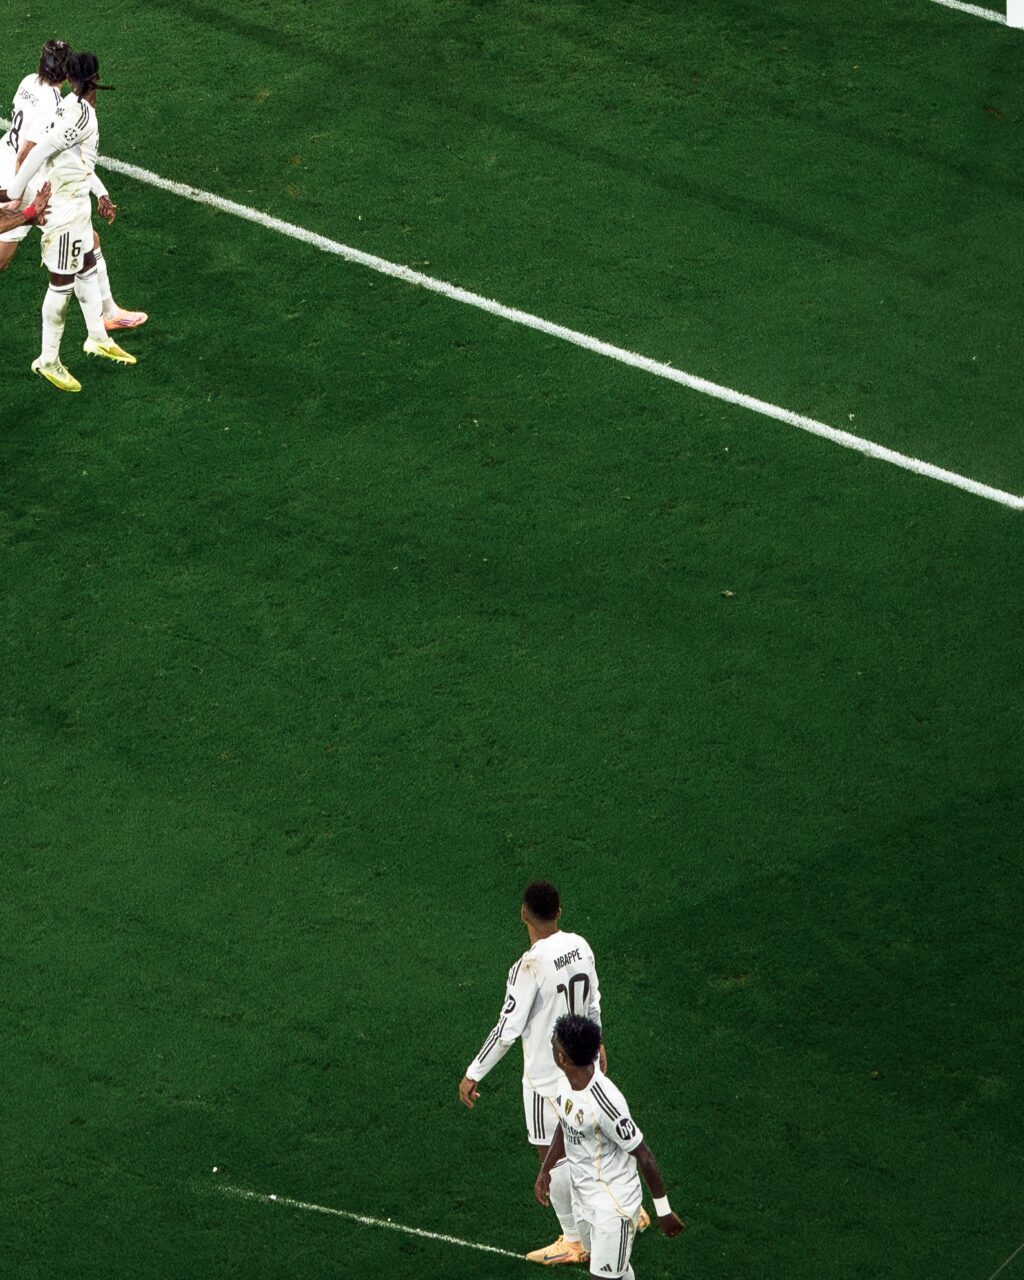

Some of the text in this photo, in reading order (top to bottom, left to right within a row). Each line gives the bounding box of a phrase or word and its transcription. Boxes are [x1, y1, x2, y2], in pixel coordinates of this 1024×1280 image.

[71, 239, 83, 258] 6
[557, 973, 590, 1017] 10
[616, 1118, 637, 1141] hp
